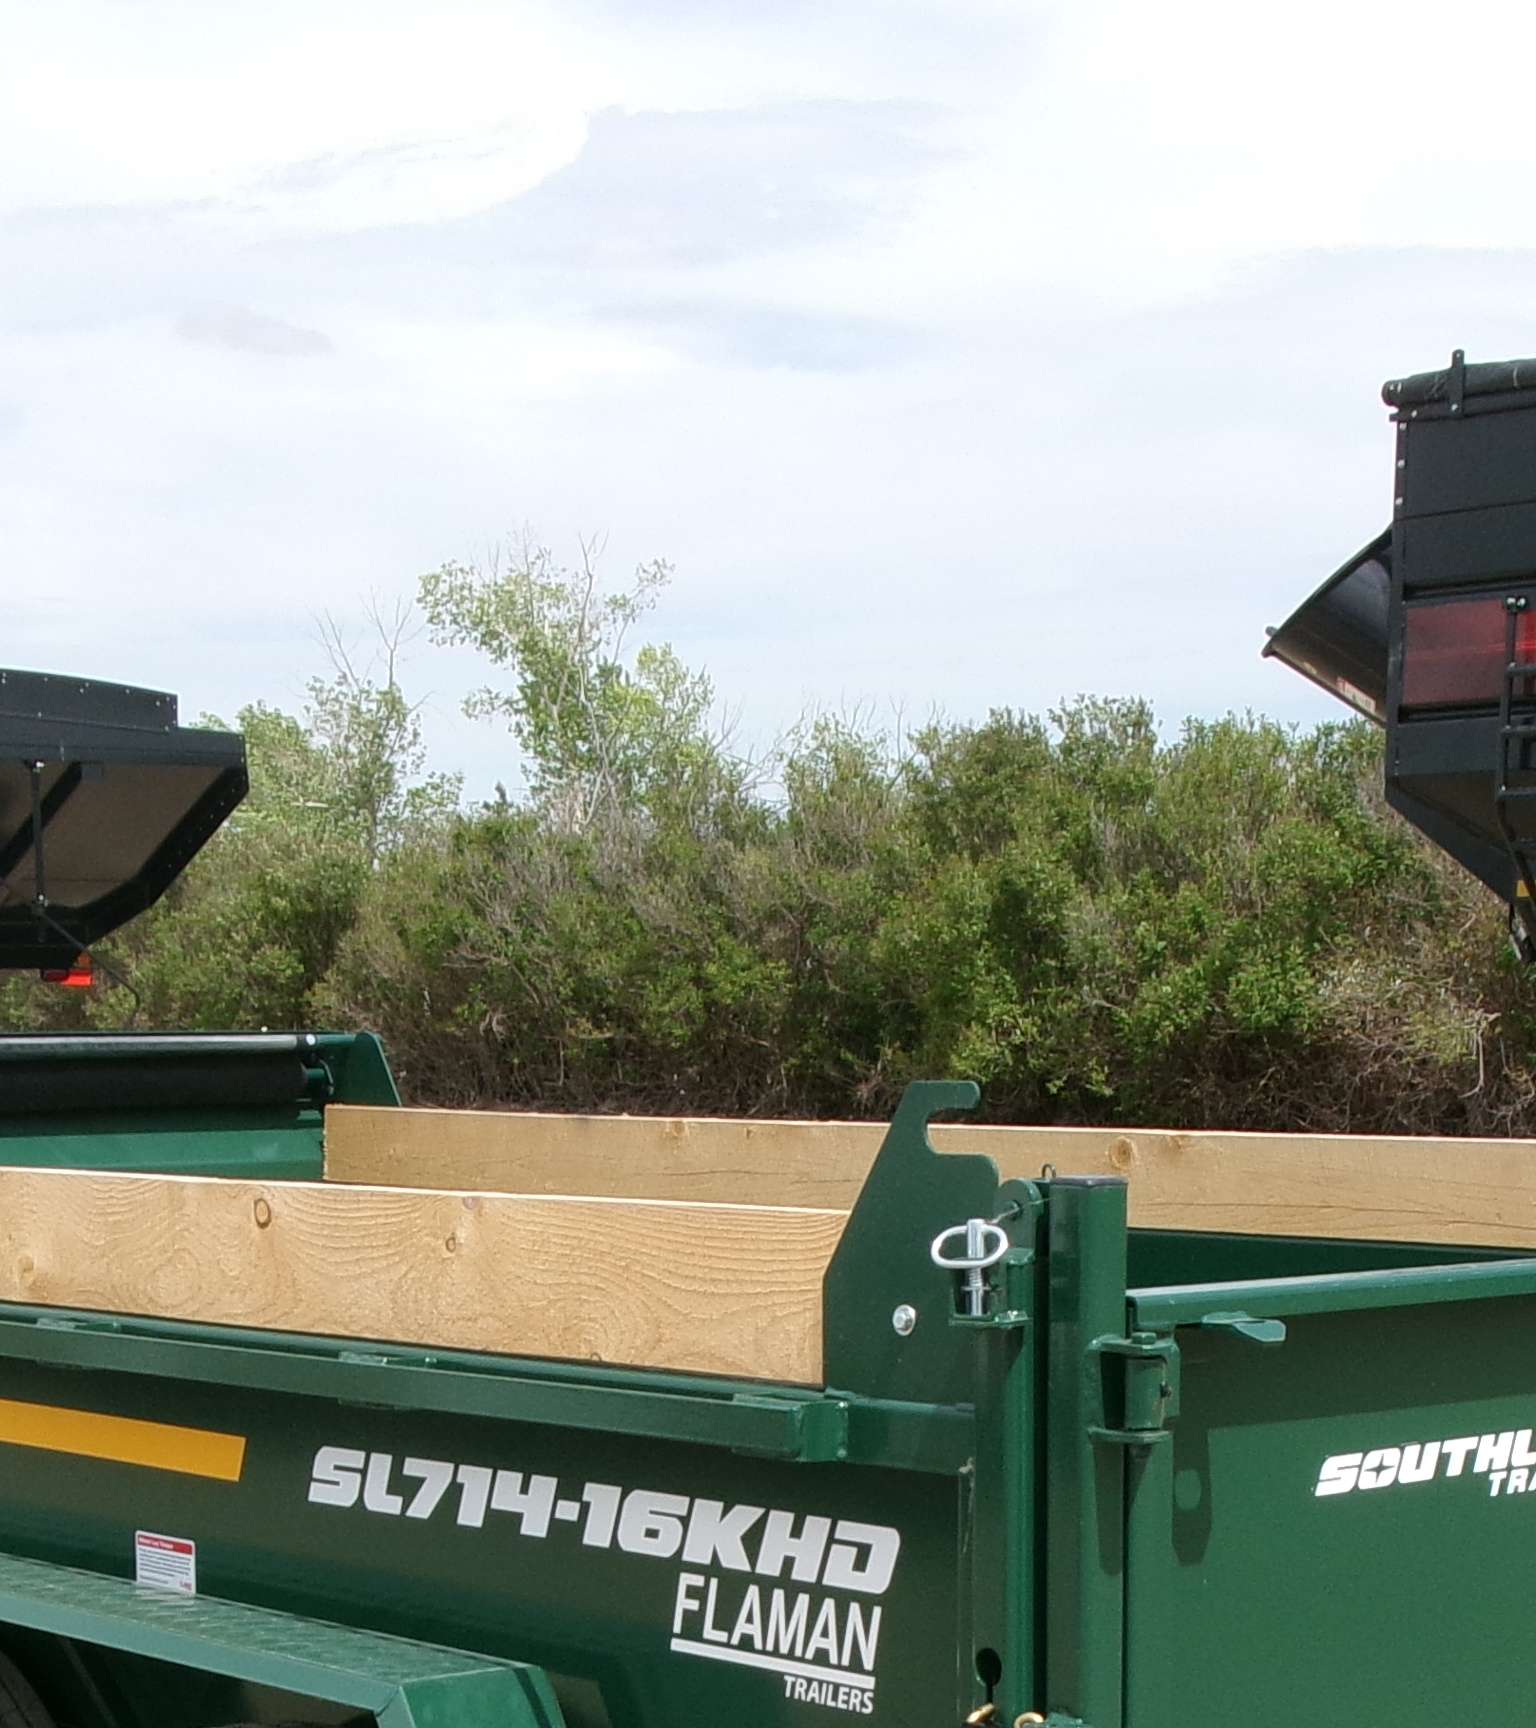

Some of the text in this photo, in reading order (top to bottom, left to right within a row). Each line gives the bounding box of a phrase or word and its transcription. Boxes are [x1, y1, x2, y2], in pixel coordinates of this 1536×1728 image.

[307, 1445, 901, 1595] SL714-16KHD
[672, 1573, 882, 1672] FLAMAN
[783, 1675, 875, 1715] TRAILERS
